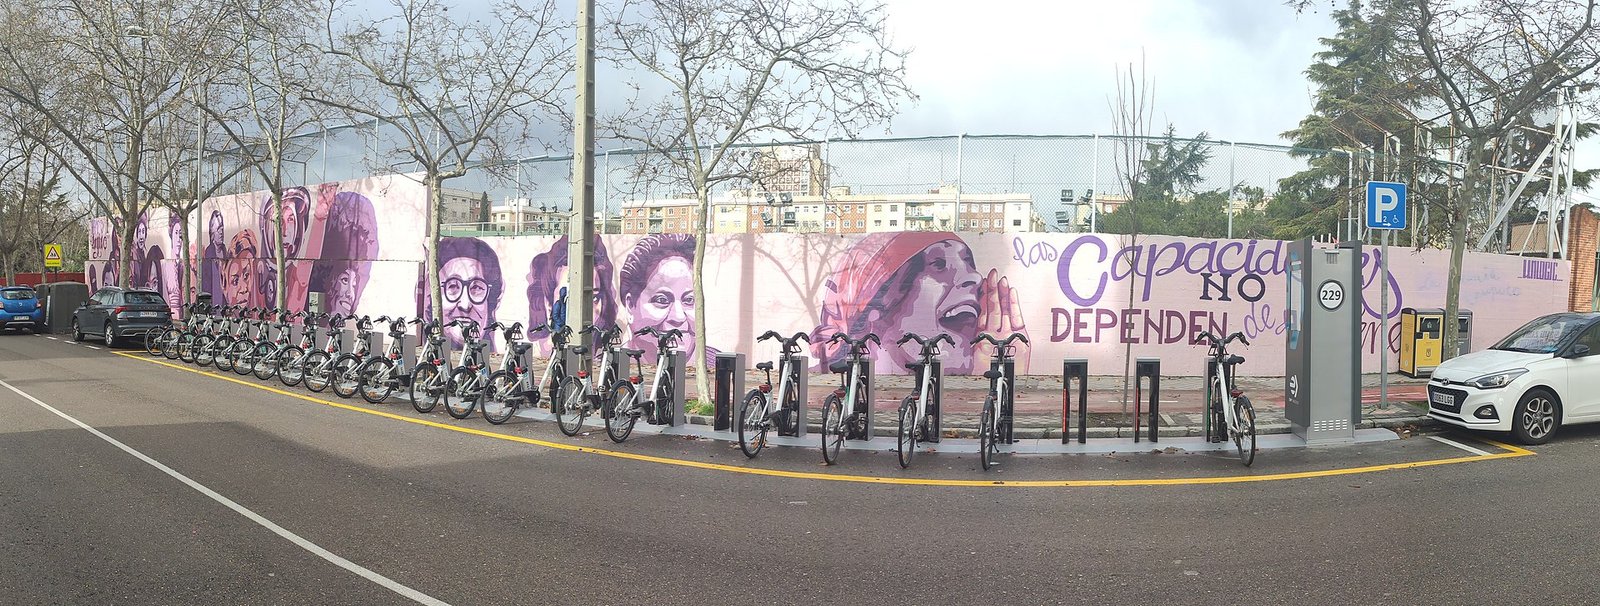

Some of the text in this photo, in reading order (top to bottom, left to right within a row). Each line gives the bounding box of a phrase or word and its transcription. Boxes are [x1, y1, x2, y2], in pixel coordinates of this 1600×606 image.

[1375, 187, 1399, 223] P
[1013, 236, 1058, 268] las
[1200, 273, 1266, 302] NO
[1321, 289, 1341, 301] 229
[1050, 307, 1228, 346] DEPENDEN
